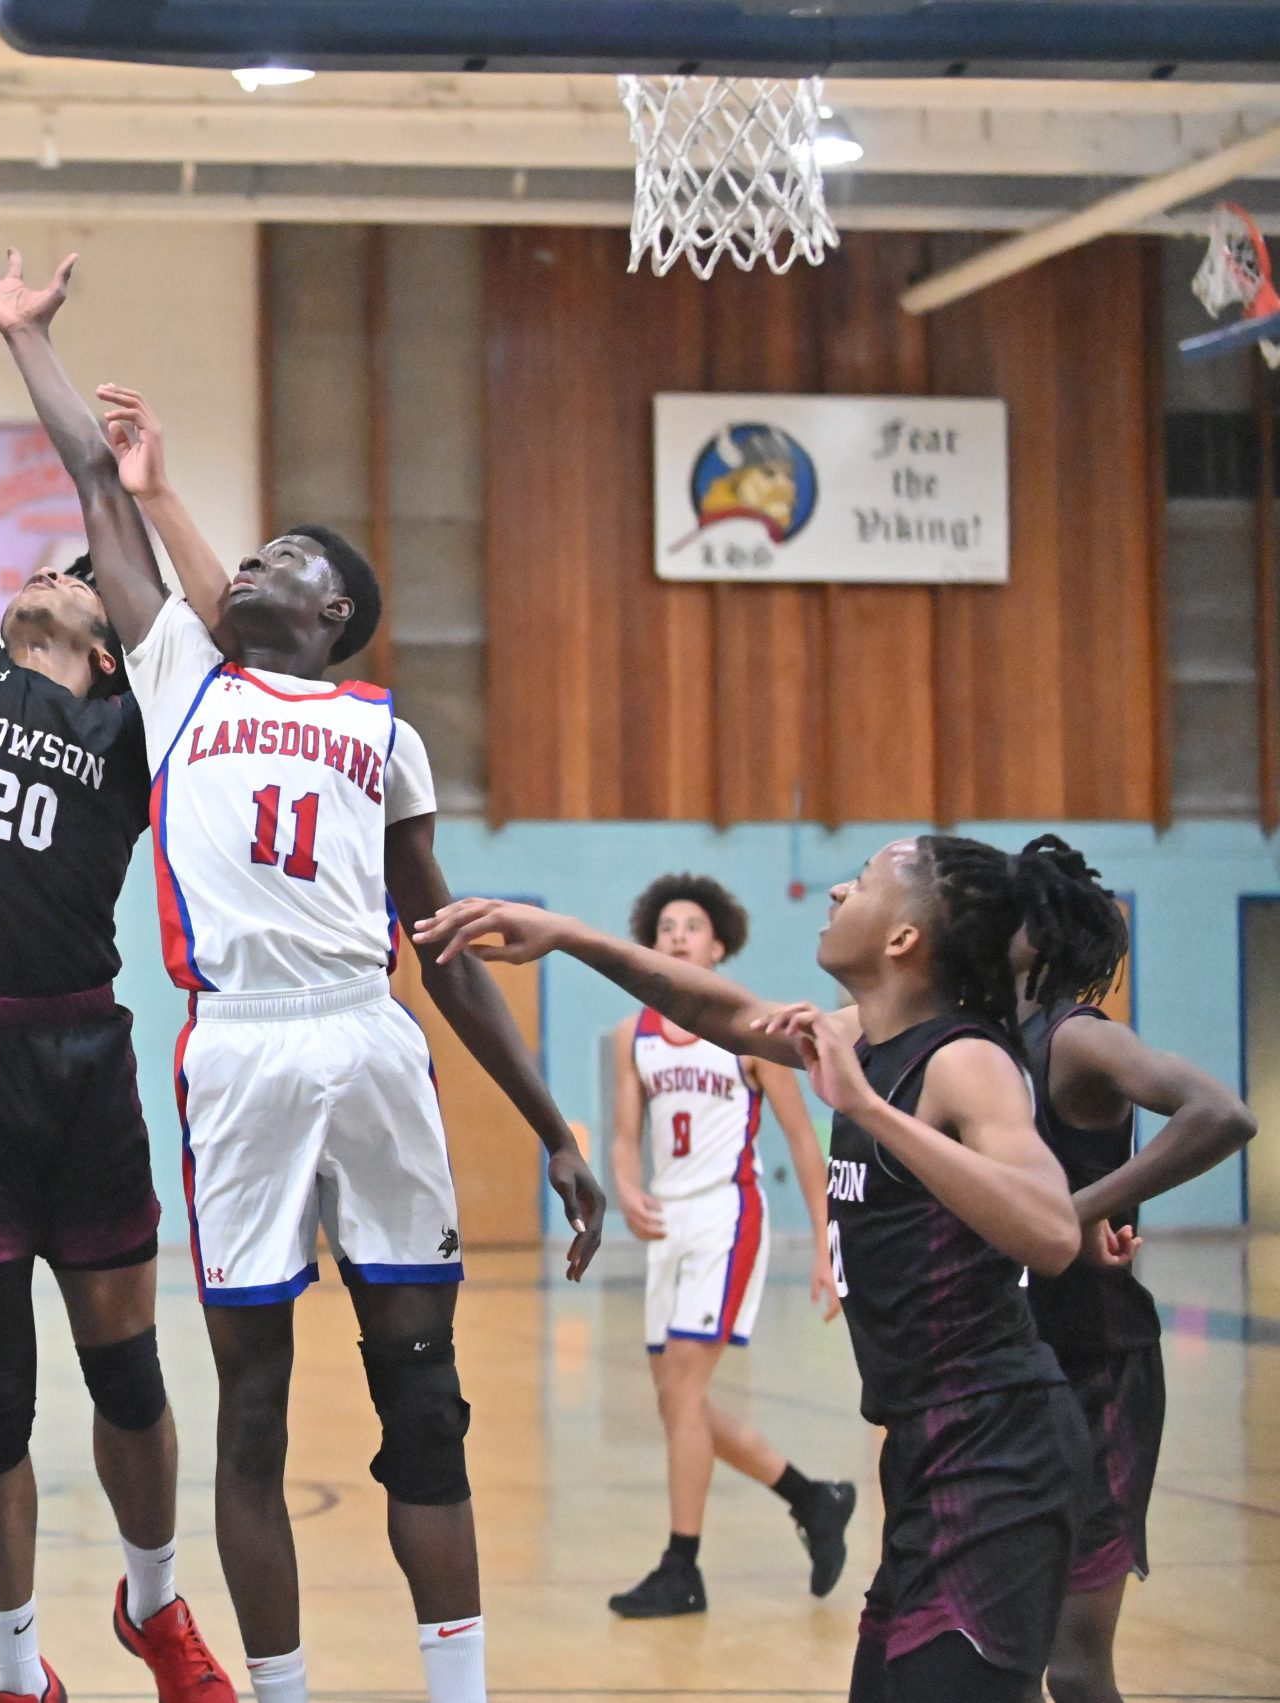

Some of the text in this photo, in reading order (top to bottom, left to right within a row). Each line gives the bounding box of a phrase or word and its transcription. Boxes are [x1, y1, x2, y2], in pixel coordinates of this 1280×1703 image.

[870, 418, 958, 461] Fear
[891, 465, 937, 500] the
[188, 717, 383, 806] LANSDOWNE
[250, 784, 320, 882] 11
[645, 1065, 735, 1101] ANSDOWNE
